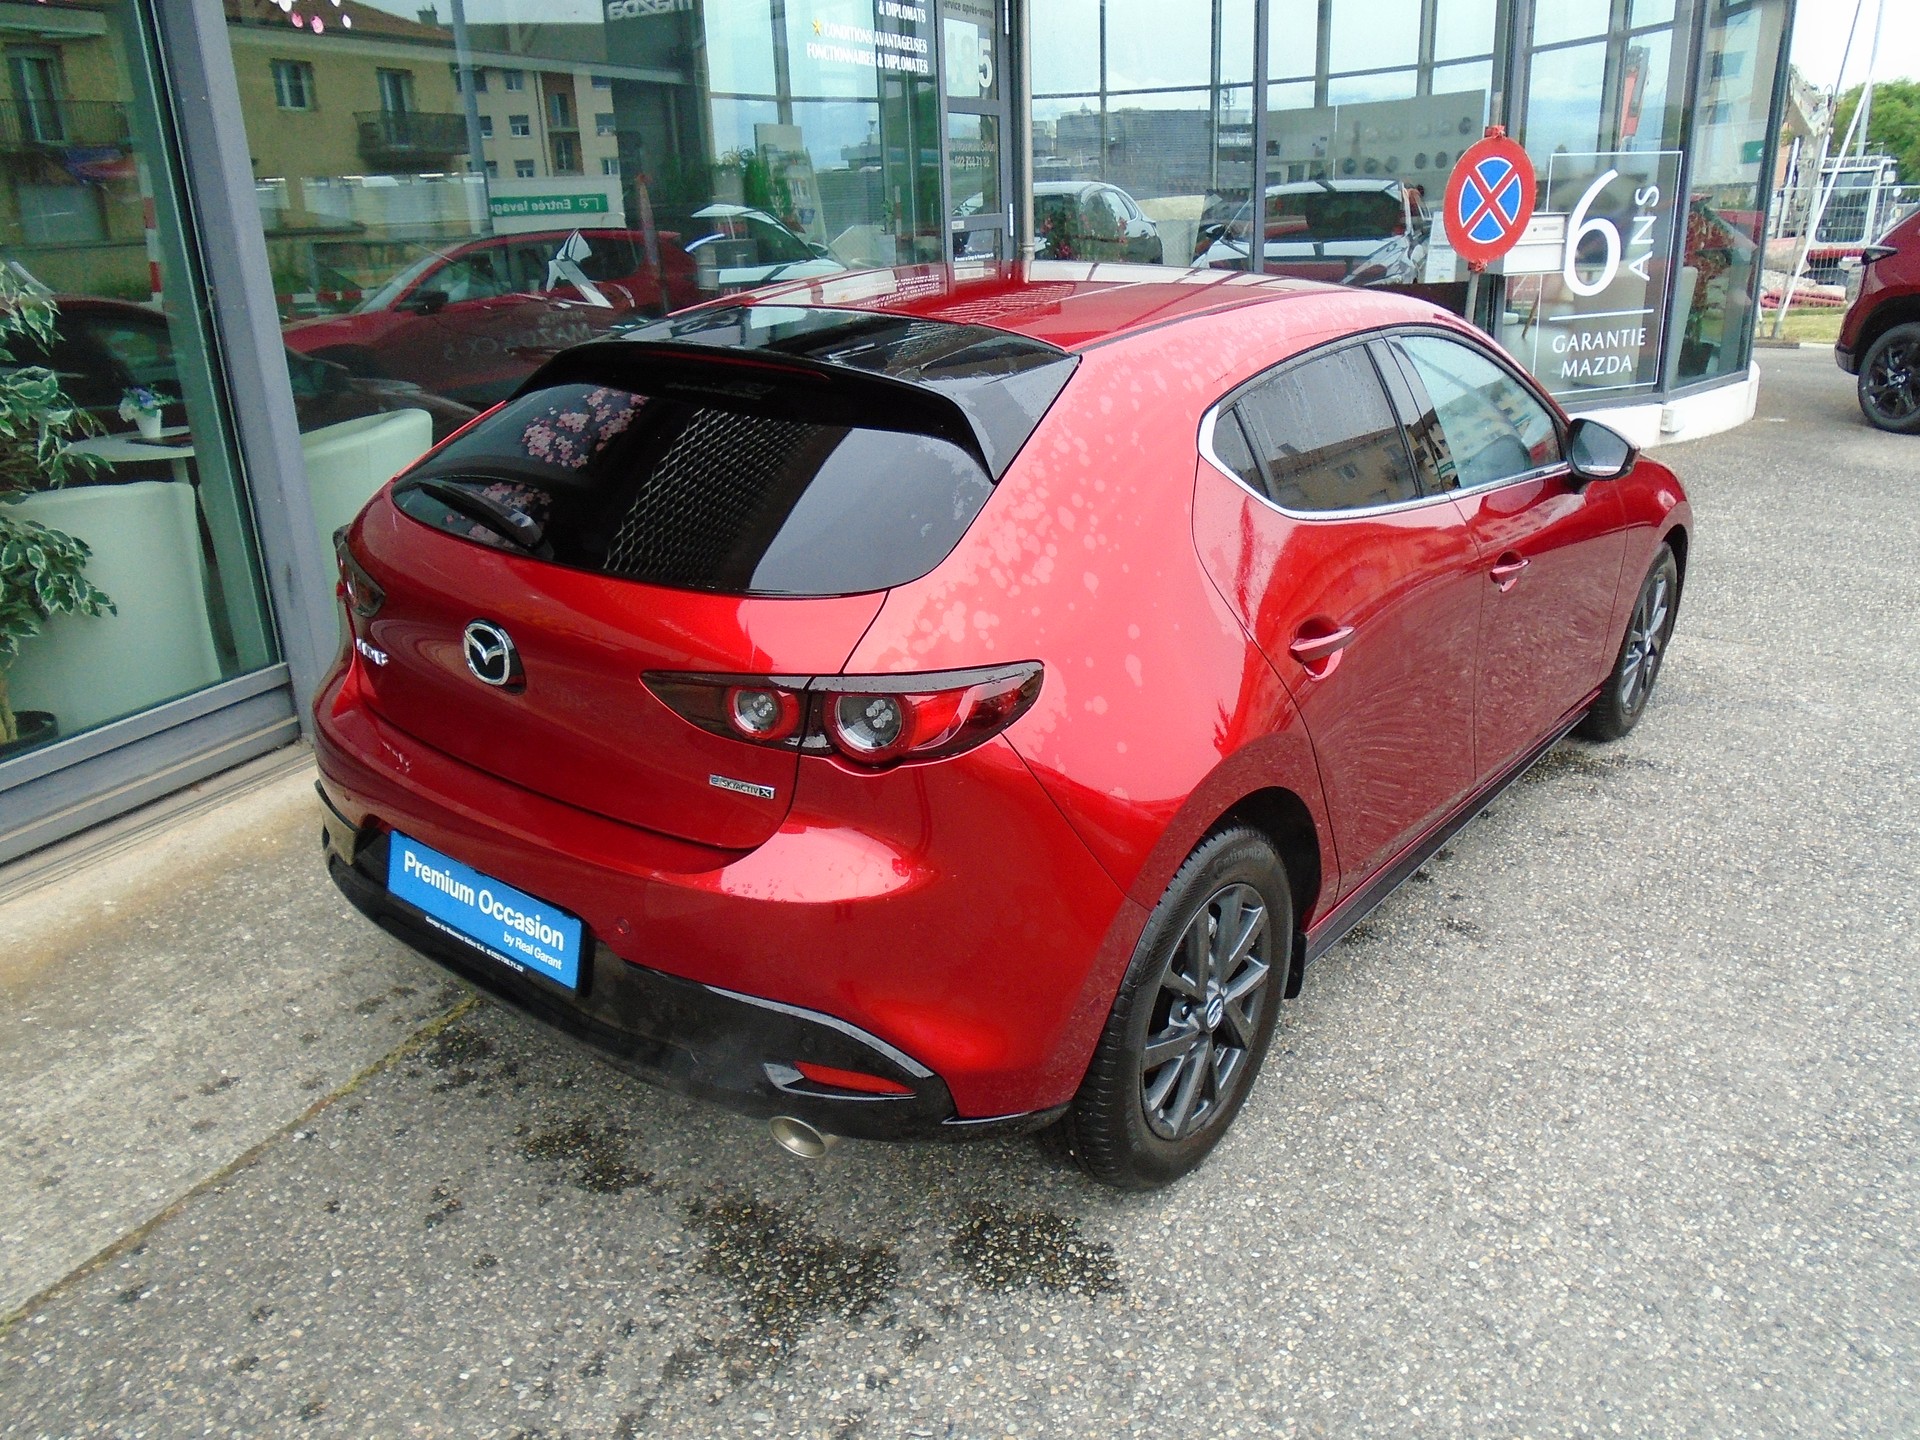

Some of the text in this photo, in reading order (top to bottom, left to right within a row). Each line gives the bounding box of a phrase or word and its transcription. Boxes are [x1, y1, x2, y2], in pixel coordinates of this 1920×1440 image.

[886, 1, 926, 23] DIPLOMATS
[823, 22, 928, 53] CONDITIONS AVANTAGEUSES
[806, 42, 876, 66] FONCTIONNAIRES
[884, 53, 929, 73] DIPLOMATES
[1563, 168, 1660, 297] 6 ANS
[1552, 327, 1647, 354] GARANTIE
[1561, 355, 1633, 378] MAZDA
[404, 850, 564, 952] Premium Occasion
[503, 931, 562, 970] by Real Garant
